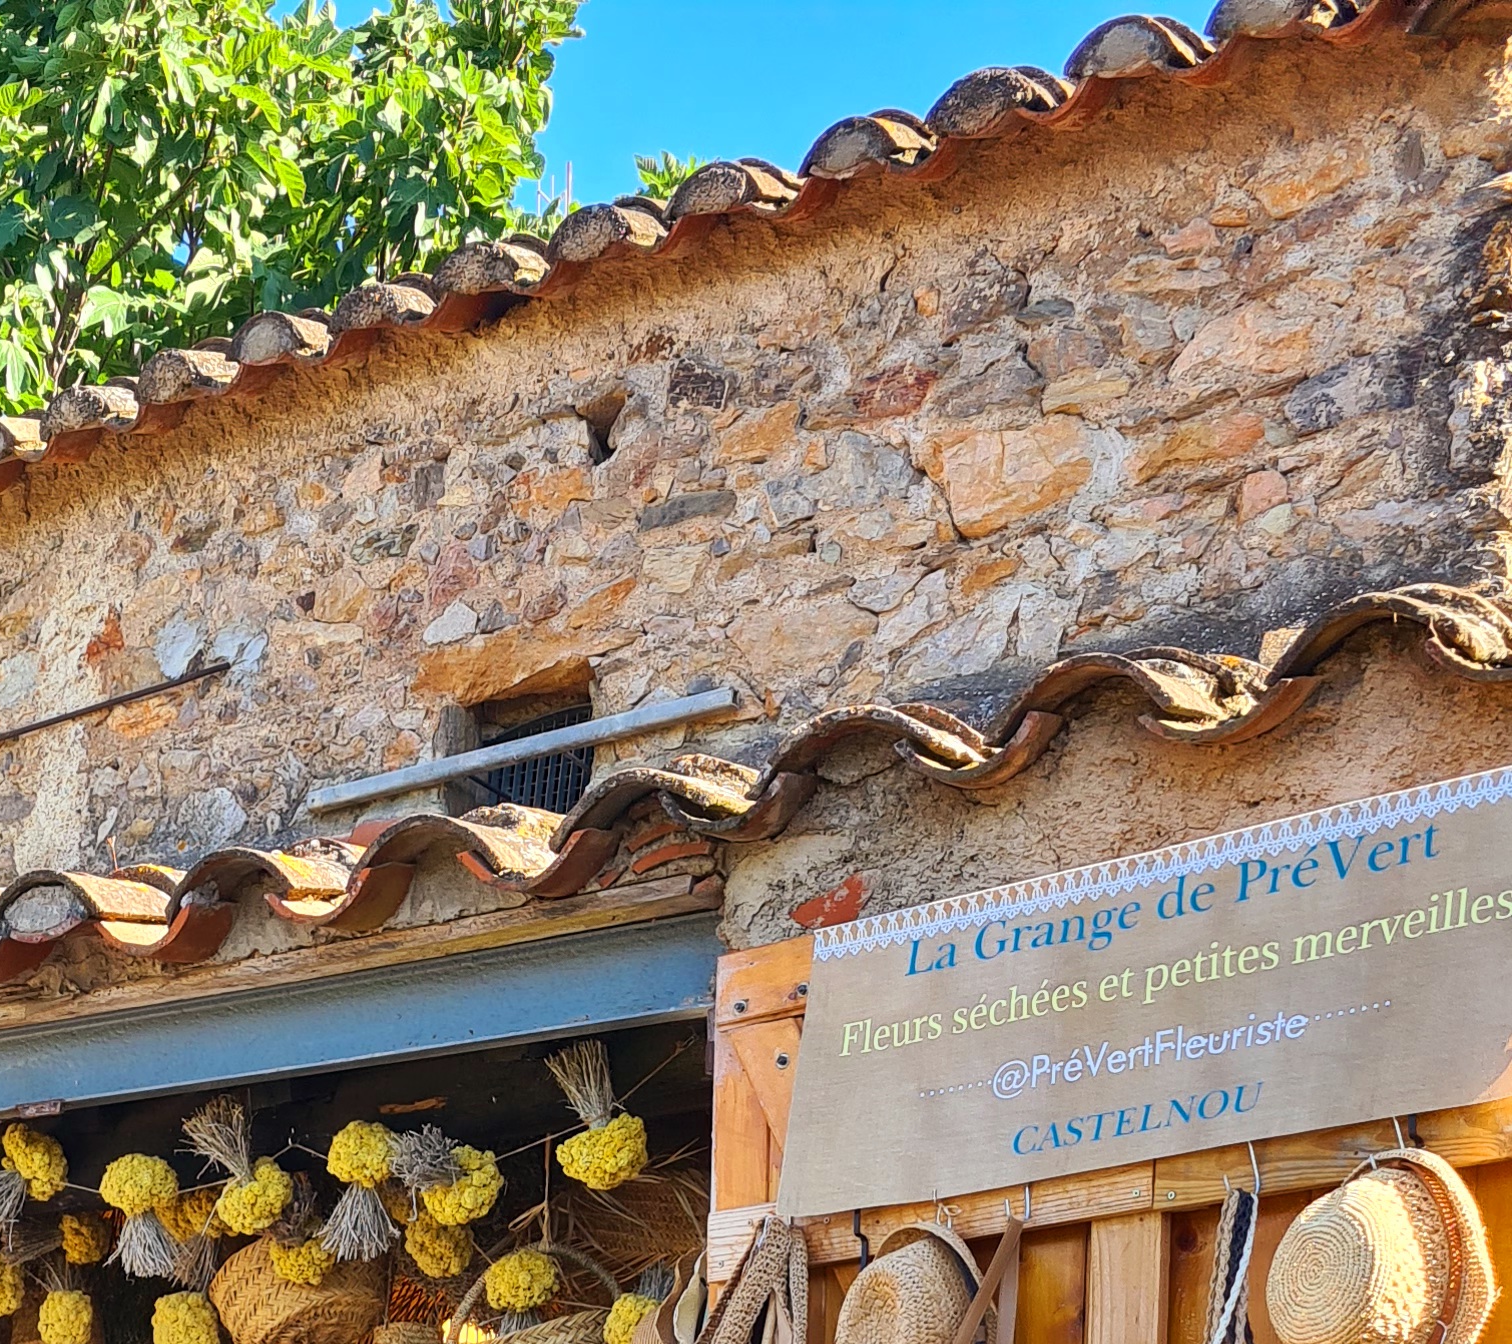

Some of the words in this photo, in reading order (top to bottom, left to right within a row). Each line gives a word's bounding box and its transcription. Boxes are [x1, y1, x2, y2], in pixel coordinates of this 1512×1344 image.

[903, 937, 957, 977] La
[974, 903, 1141, 961] Grange
[1156, 876, 1216, 921] de
[1236, 825, 1440, 903] PréVert
[838, 1008, 944, 1057] Fleurs
[951, 980, 1089, 1034] séchées
[1099, 971, 1134, 1001] et
[1142, 938, 1280, 1004] petites
[1291, 888, 1512, 964] merveilles
[992, 1008, 1309, 1099] @PréVertFleuriste
[1011, 1082, 1264, 1156] CASTELNOU
